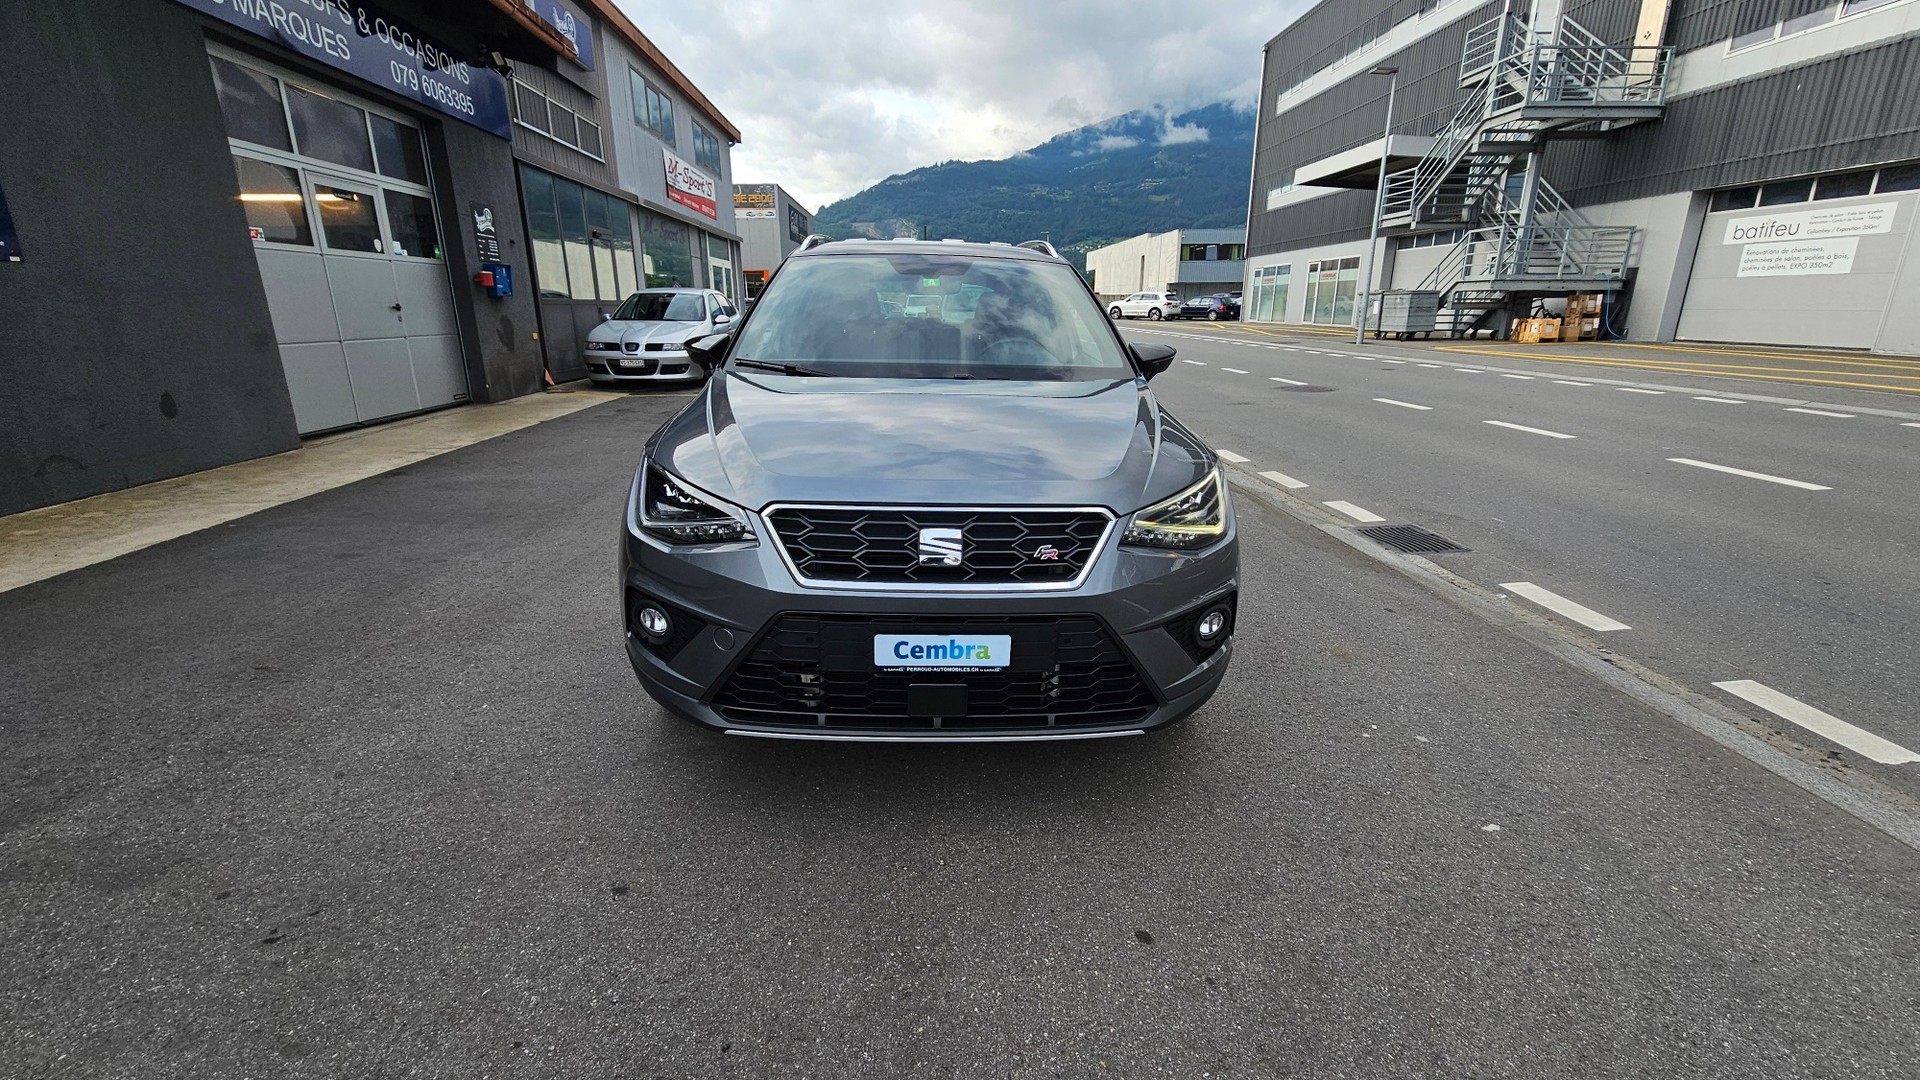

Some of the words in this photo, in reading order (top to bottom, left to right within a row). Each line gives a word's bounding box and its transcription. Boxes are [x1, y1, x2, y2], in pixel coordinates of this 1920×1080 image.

[232, 0, 351, 60] MARQUES
[358, 8, 372, 36] &
[375, 18, 470, 85] OCCASIONS
[390, 60, 419, 91] 079
[421, 75, 475, 116] 6063395
[1732, 220, 1801, 241] batifeu
[1836, 225, 1861, 233] Exposition
[1789, 262, 1808, 270] EXPO
[1809, 261, 1834, 269] 350m2
[1833, 252, 1850, 260] bois,
[1033, 544, 1059, 560] FR
[893, 639, 991, 660] Cembra
